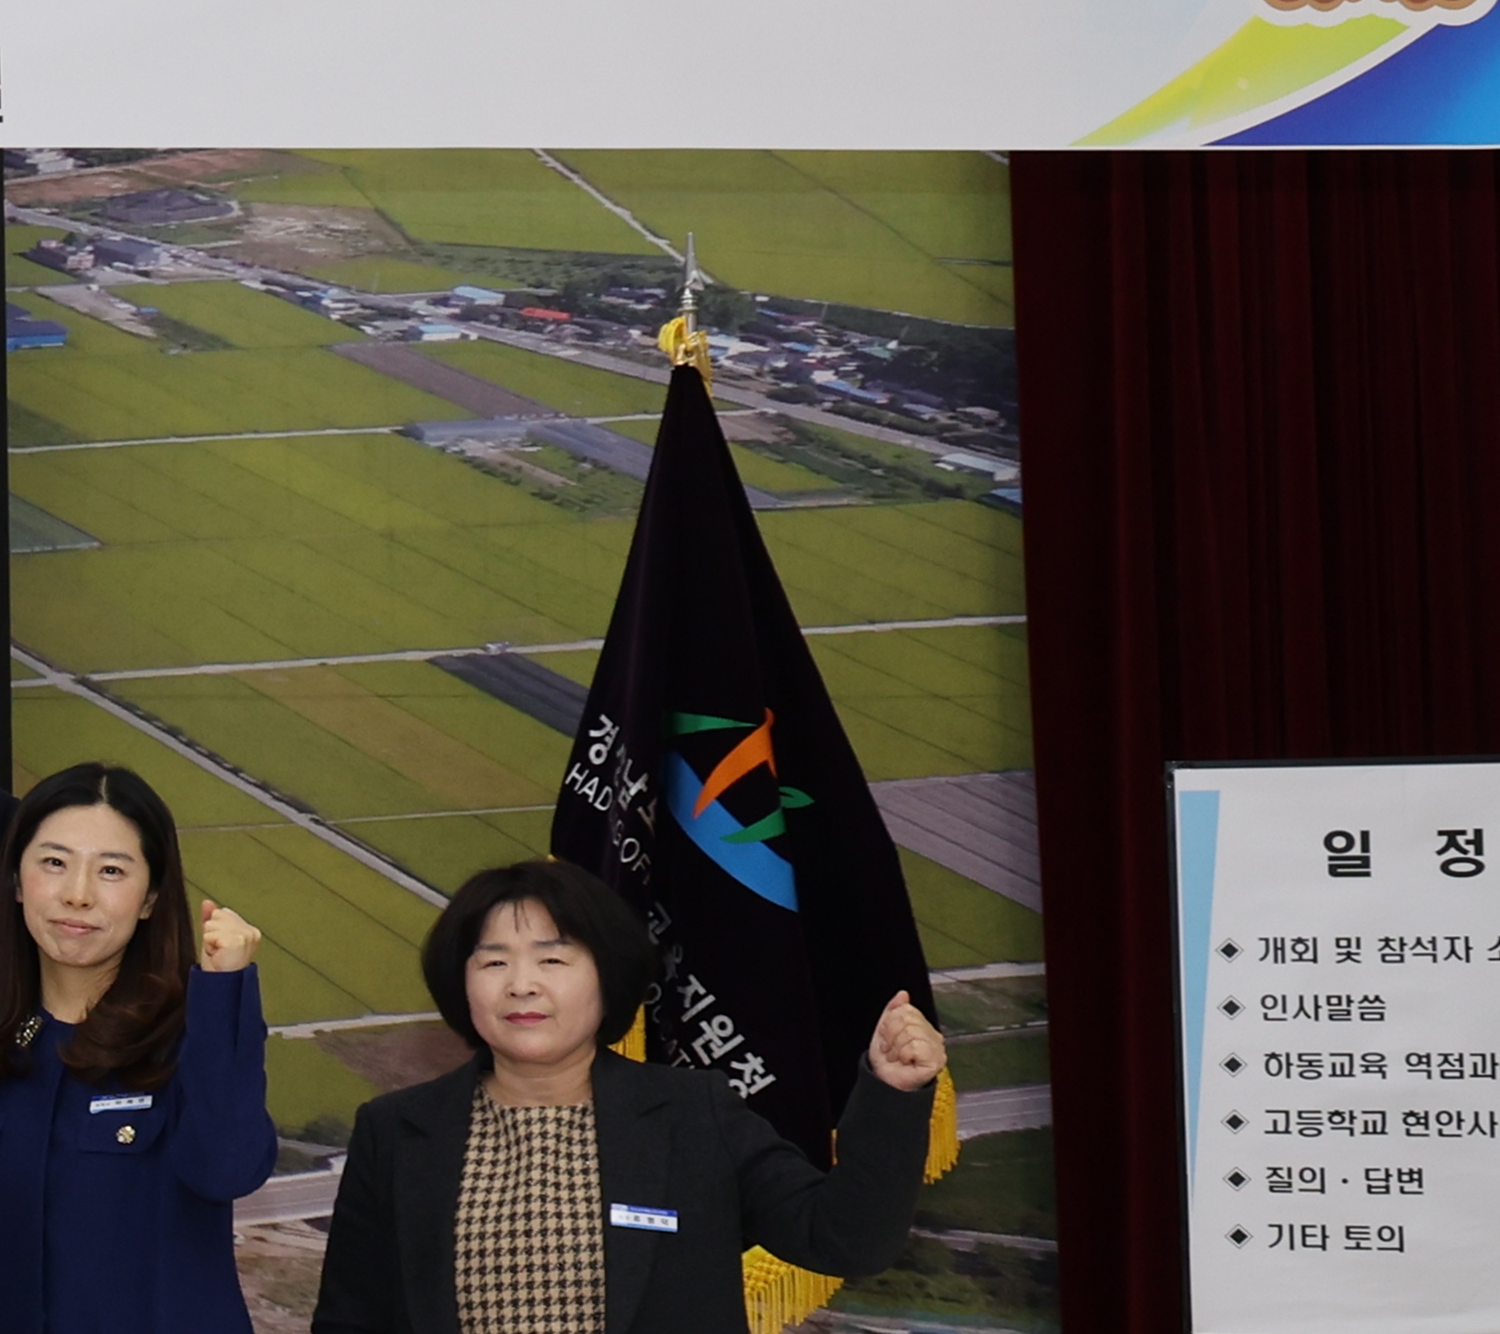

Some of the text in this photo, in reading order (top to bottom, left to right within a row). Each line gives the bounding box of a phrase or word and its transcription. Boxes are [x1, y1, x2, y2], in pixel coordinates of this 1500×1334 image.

[1258, 936, 1319, 964] 개회
[1334, 936, 1363, 964] 및
[1377, 935, 1474, 964] 참석자
[1260, 994, 1387, 1022] 인사말씀
[1264, 1052, 1500, 1081] 하동교육 역점과
[1264, 1109, 1499, 1139] 고등학교 현안사
[1265, 1166, 1326, 1195] 질의
[1364, 1167, 1424, 1196] 답변
[1267, 1224, 1405, 1254] 기타 토의
